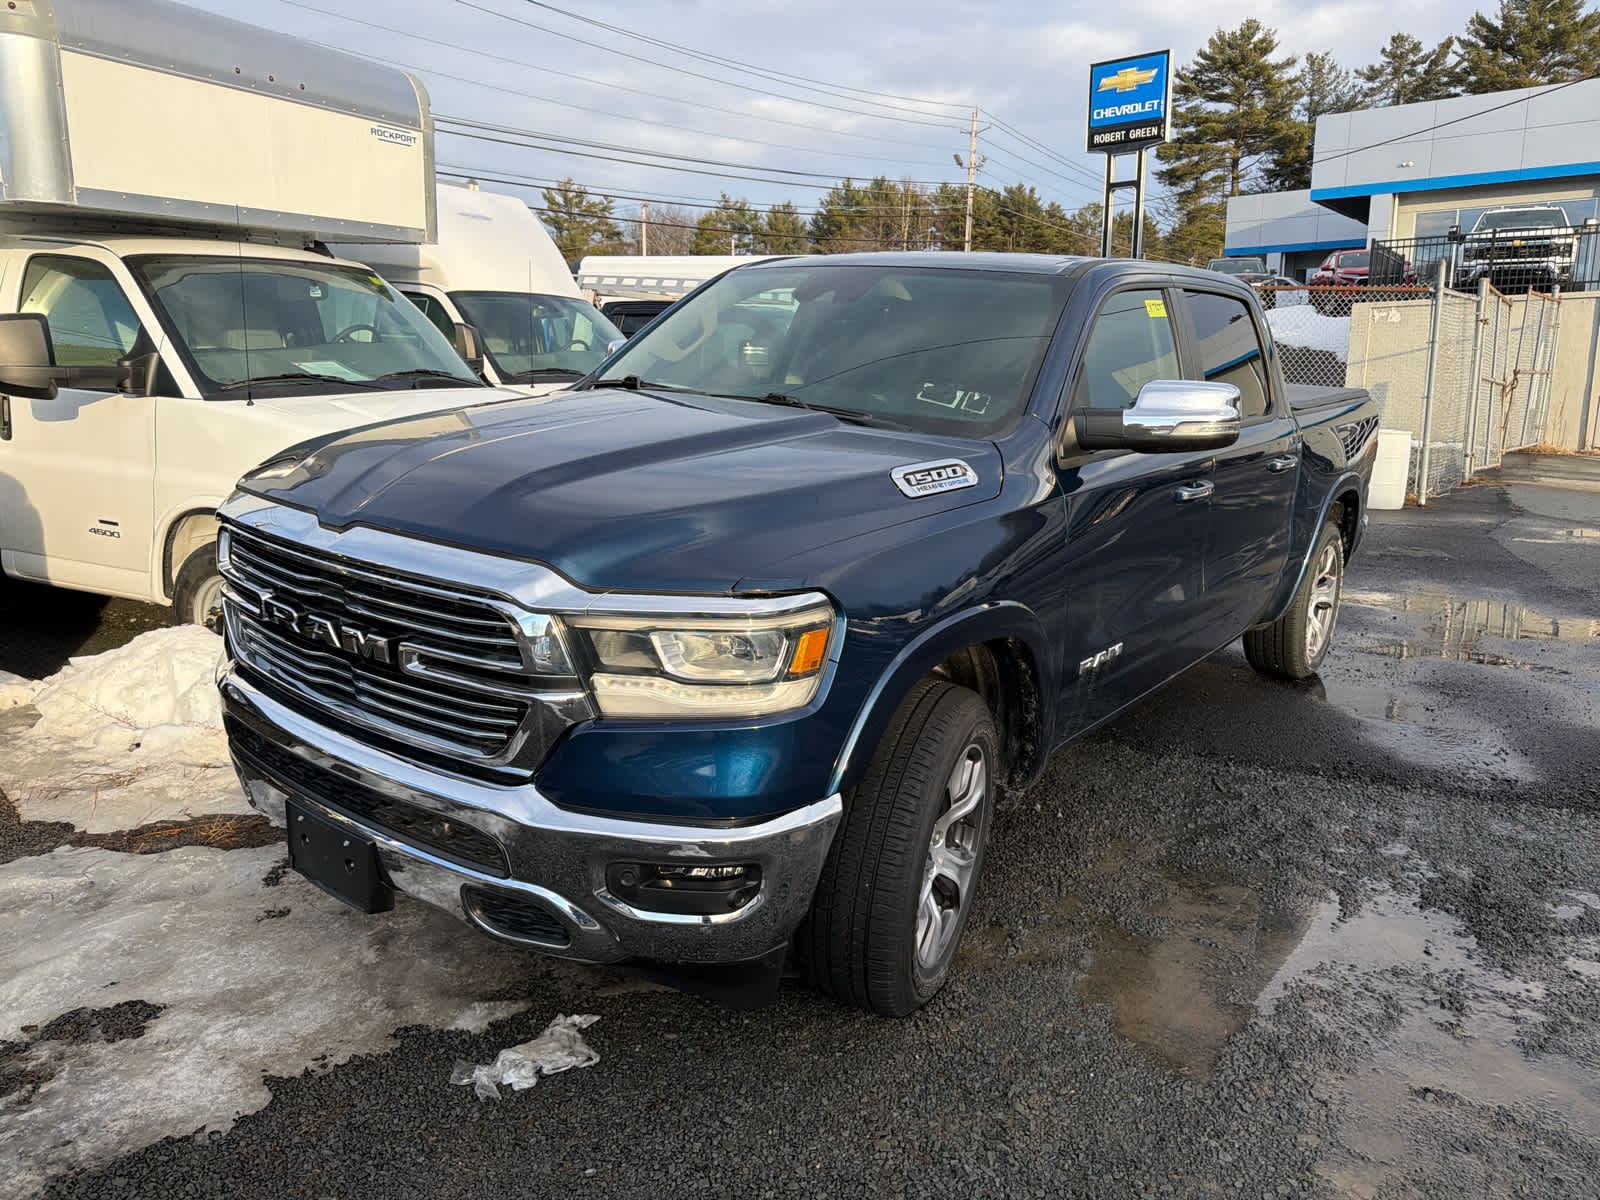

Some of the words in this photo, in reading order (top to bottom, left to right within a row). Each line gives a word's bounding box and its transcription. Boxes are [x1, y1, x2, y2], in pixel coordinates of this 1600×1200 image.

[1093, 100, 1160, 120] CHEVROLET
[370, 127, 417, 144] ROCKPORT
[1094, 130, 1126, 144] ROBERT
[1129, 126, 1158, 140] GREEN
[903, 466, 963, 486] 1500
[260, 597, 391, 665] RAM
[1079, 641, 1124, 675] RAM
